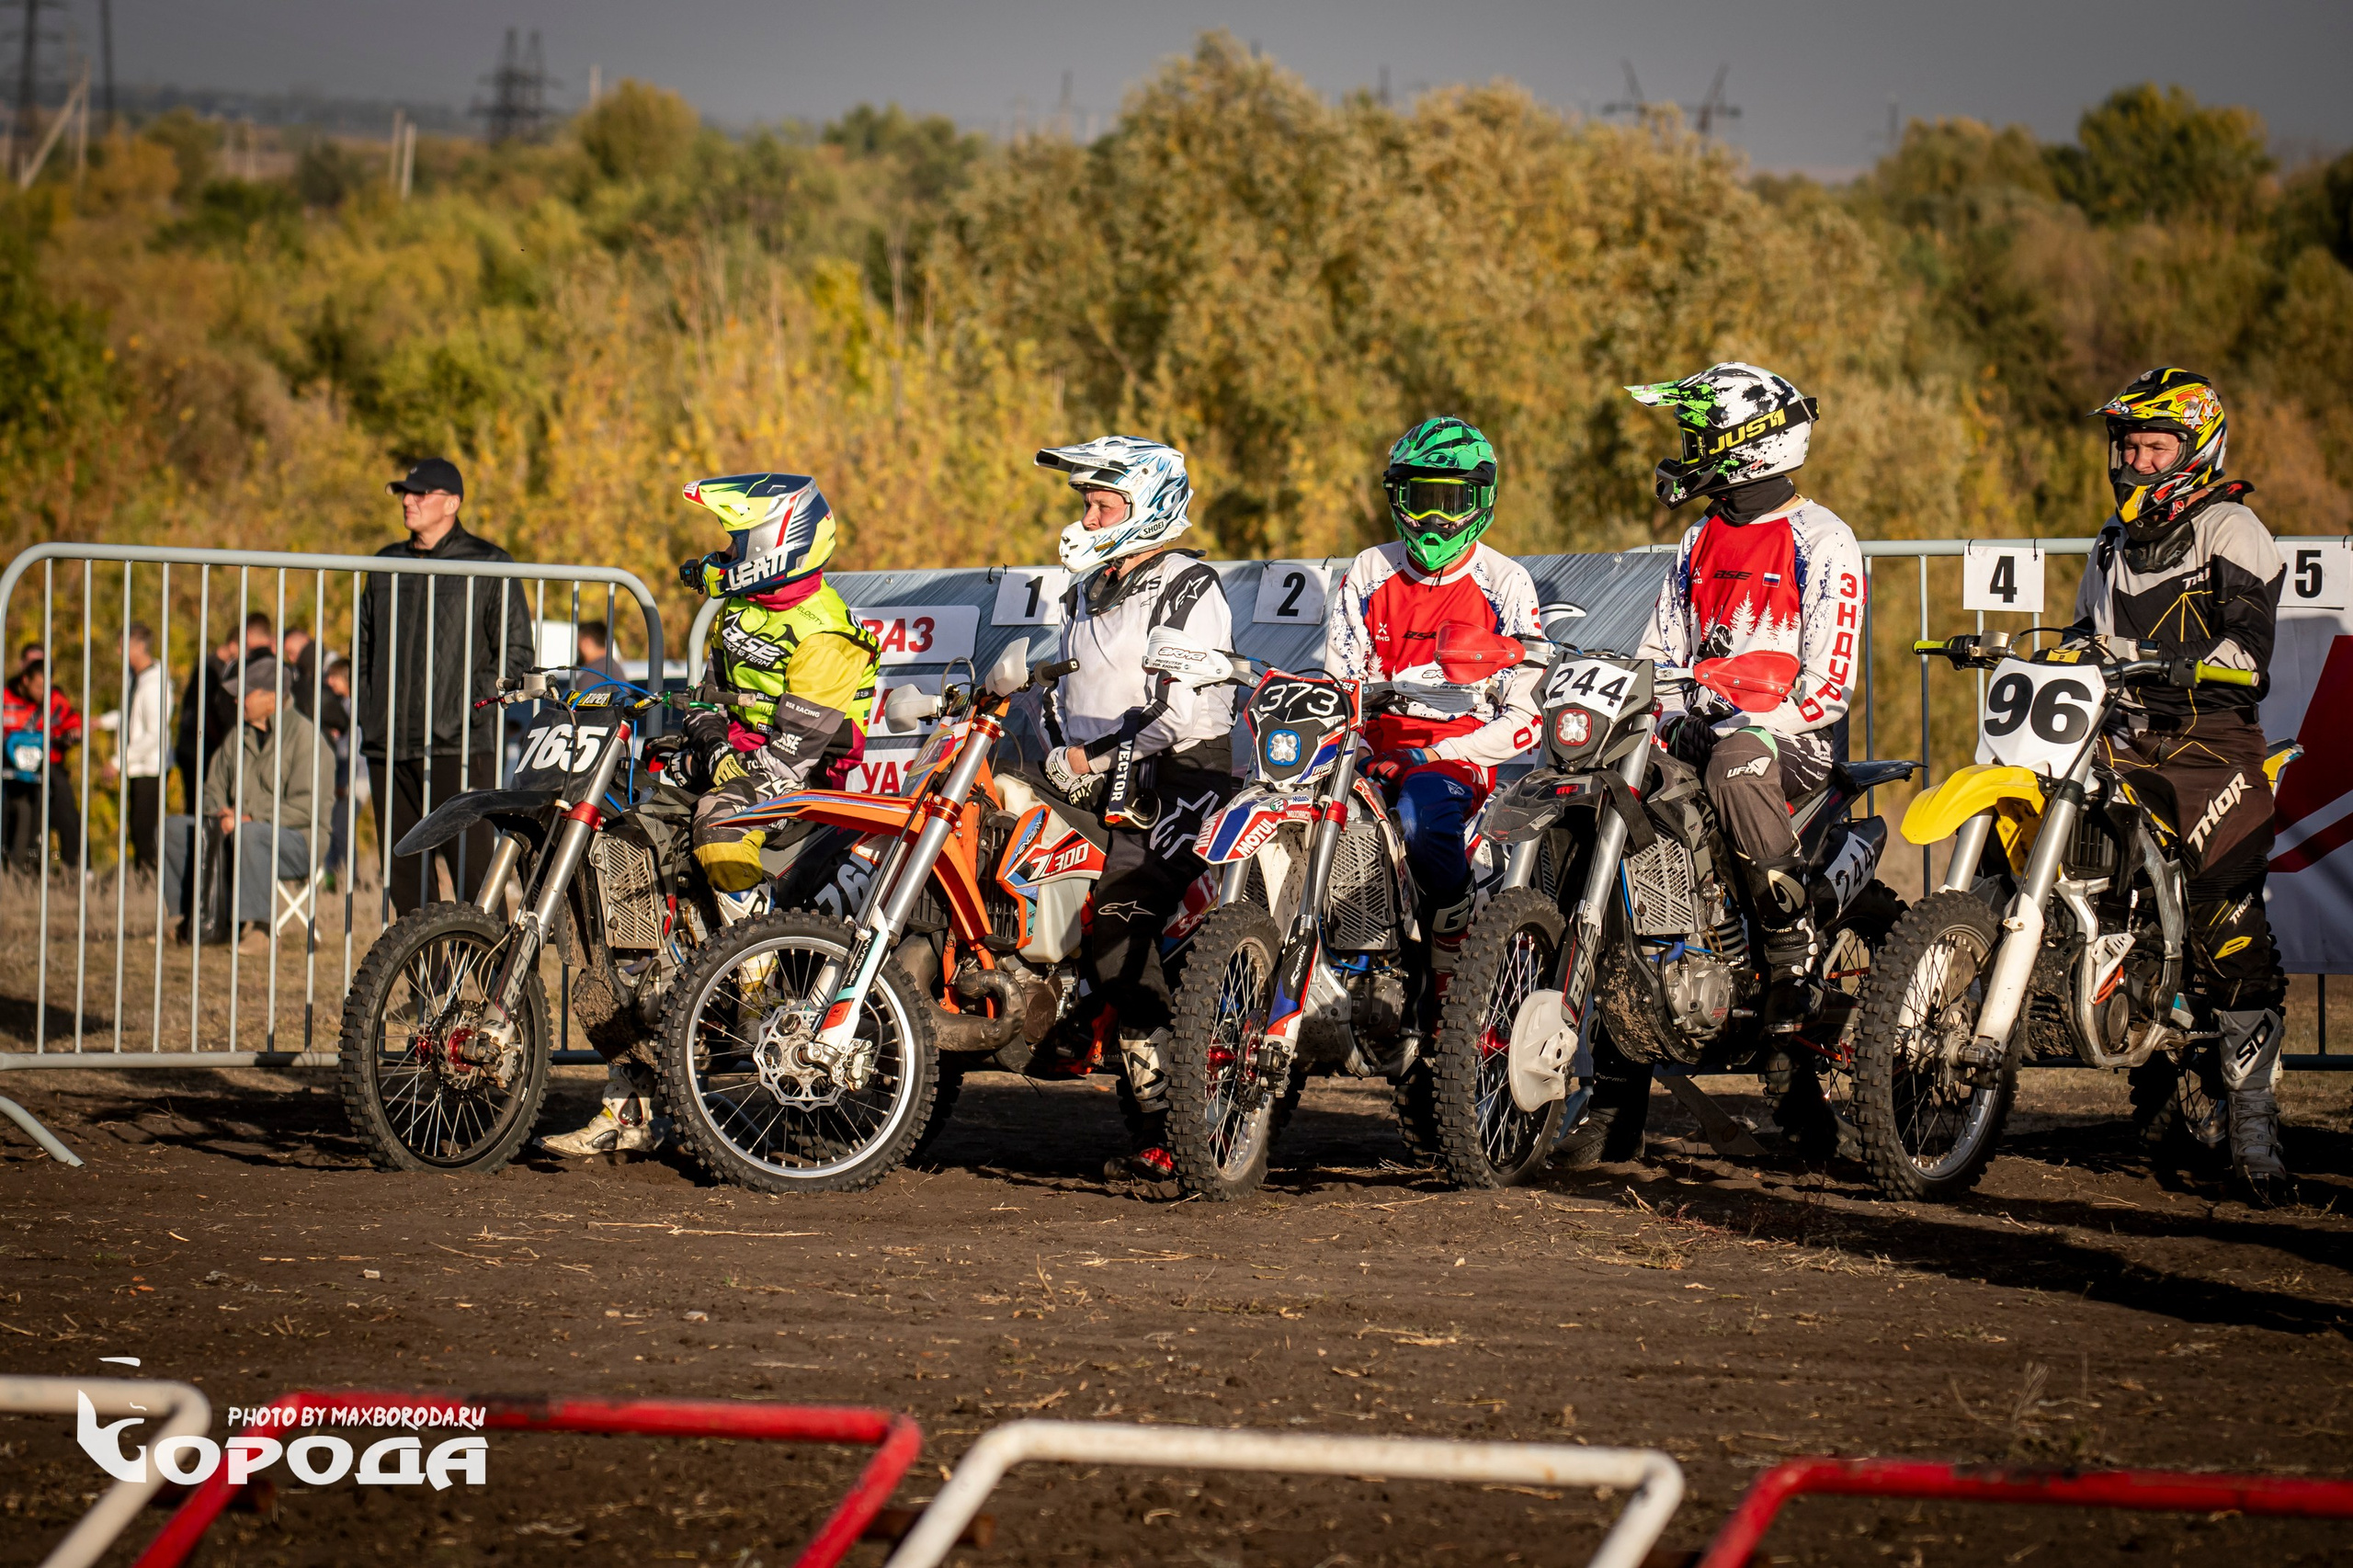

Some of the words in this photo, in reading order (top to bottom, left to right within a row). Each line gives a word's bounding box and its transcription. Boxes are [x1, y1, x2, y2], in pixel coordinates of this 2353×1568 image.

[1142, 521, 1165, 536] SHOEI
[726, 543, 796, 591] LEATT
[1990, 555, 2018, 603] 4
[2295, 550, 2323, 598] 5
[1025, 576, 1044, 618] 1
[1277, 572, 1306, 617] 2
[1258, 682, 1339, 717] 373
[1549, 666, 1629, 708] 244
[1984, 673, 2093, 744] 96
[797, 706, 821, 718] RACING
[514, 722, 609, 773] 765
[1110, 739, 1132, 802] VECTOR
[2187, 772, 2253, 853] THOR
[1053, 842, 1089, 873] 300
[1235, 817, 1279, 858] MOTUL
[1836, 839, 1875, 905] 244
[2229, 892, 2255, 925] THOR
